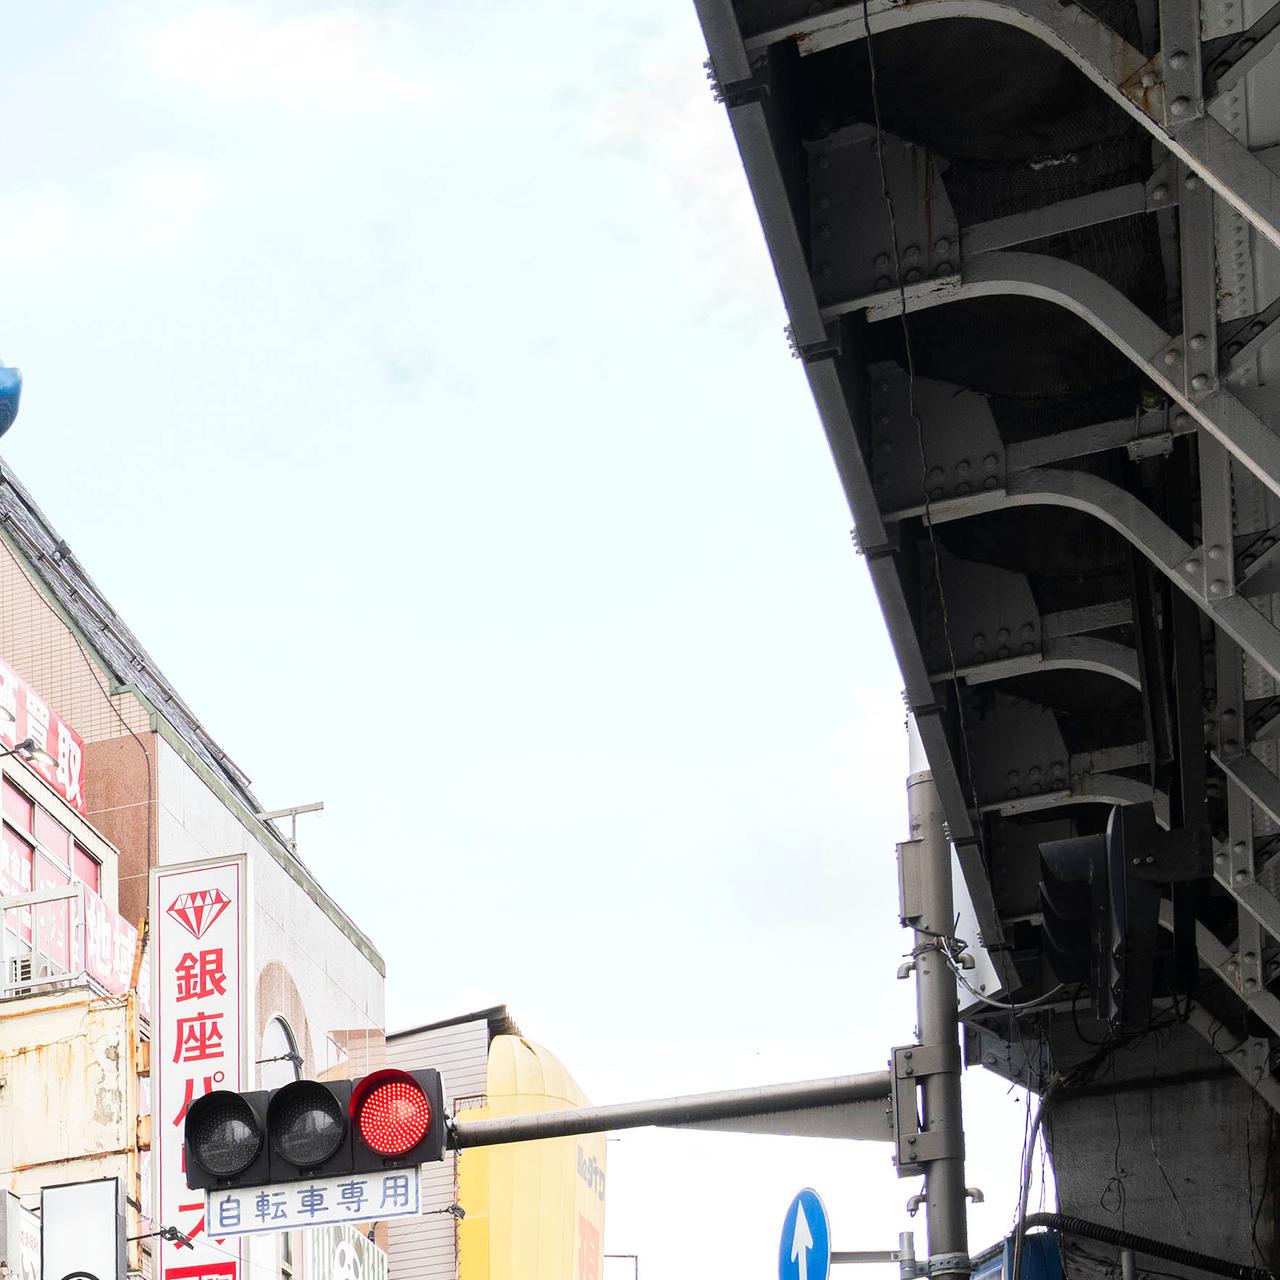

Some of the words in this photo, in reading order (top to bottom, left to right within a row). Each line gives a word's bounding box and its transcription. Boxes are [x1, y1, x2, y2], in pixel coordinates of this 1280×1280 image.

[219, 1174, 412, 1228] 自転車専用
